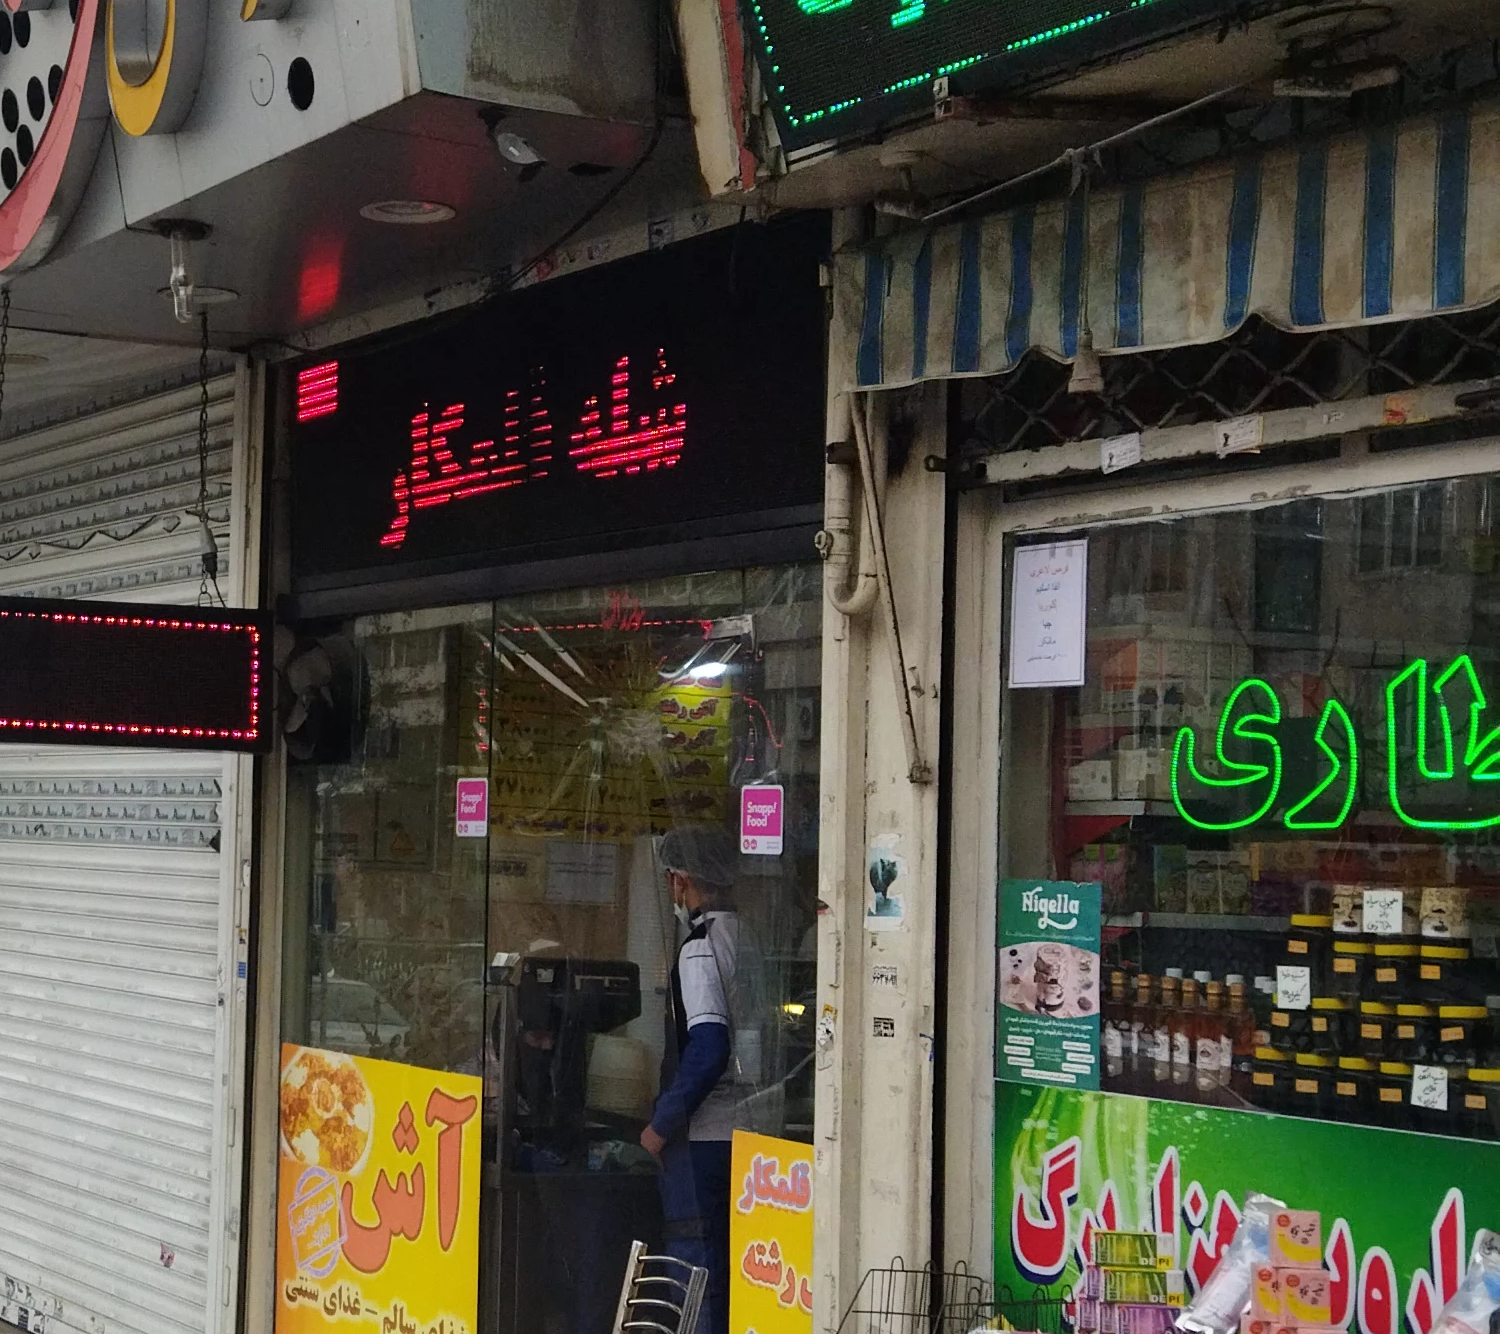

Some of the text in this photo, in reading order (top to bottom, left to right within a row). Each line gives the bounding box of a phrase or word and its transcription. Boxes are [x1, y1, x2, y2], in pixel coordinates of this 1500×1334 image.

[460, 802, 477, 814] Food
[746, 815, 768, 827] Food
[747, 801, 777, 817] Snapp!
[1022, 886, 1080, 930] Nigella
[341, 1087, 478, 1275] آش
[739, 1157, 811, 1209] قلمکار
[743, 1241, 796, 1304] رشته
[285, 1276, 320, 1304] سنتی
[323, 1284, 362, 1316] غذای
